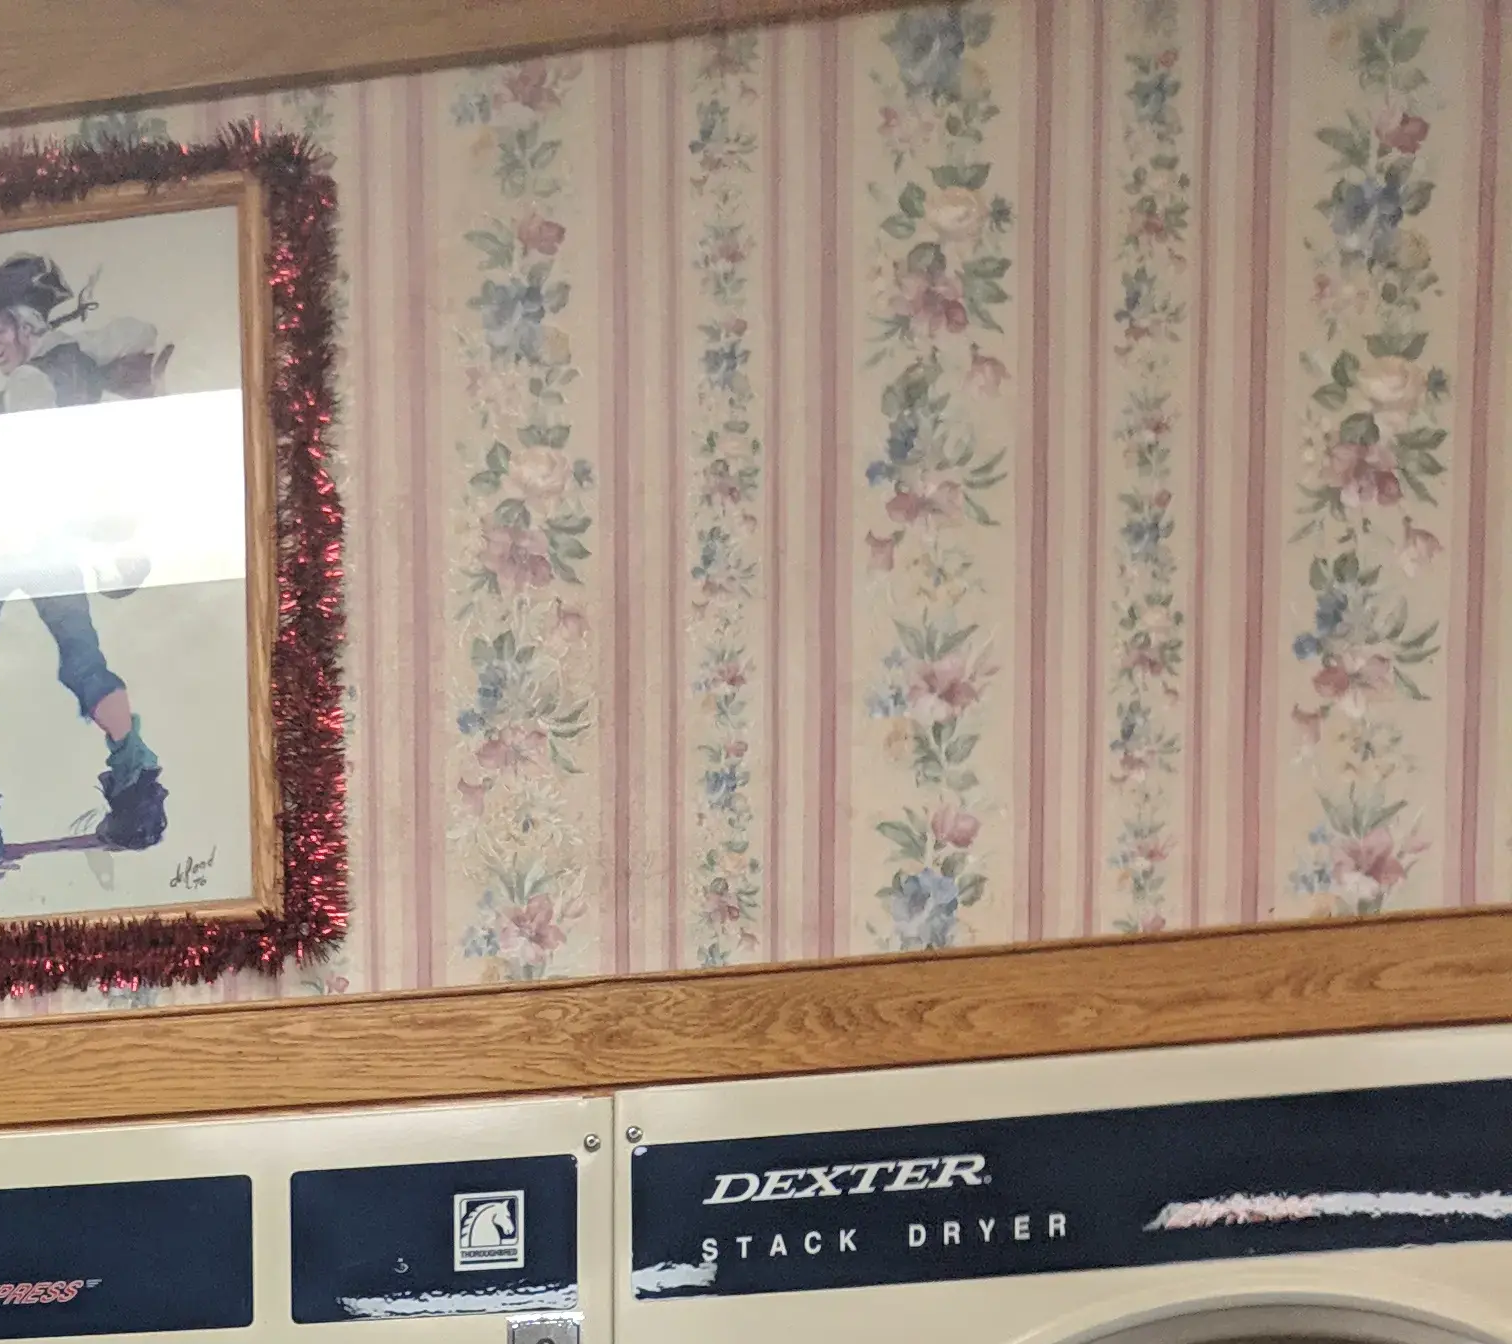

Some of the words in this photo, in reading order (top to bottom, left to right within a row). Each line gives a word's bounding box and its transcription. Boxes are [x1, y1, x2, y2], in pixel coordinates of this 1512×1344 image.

[702, 1153, 987, 1205] DEXTER
[701, 1228, 858, 1263] STACK
[908, 1212, 1067, 1248] DRYER
